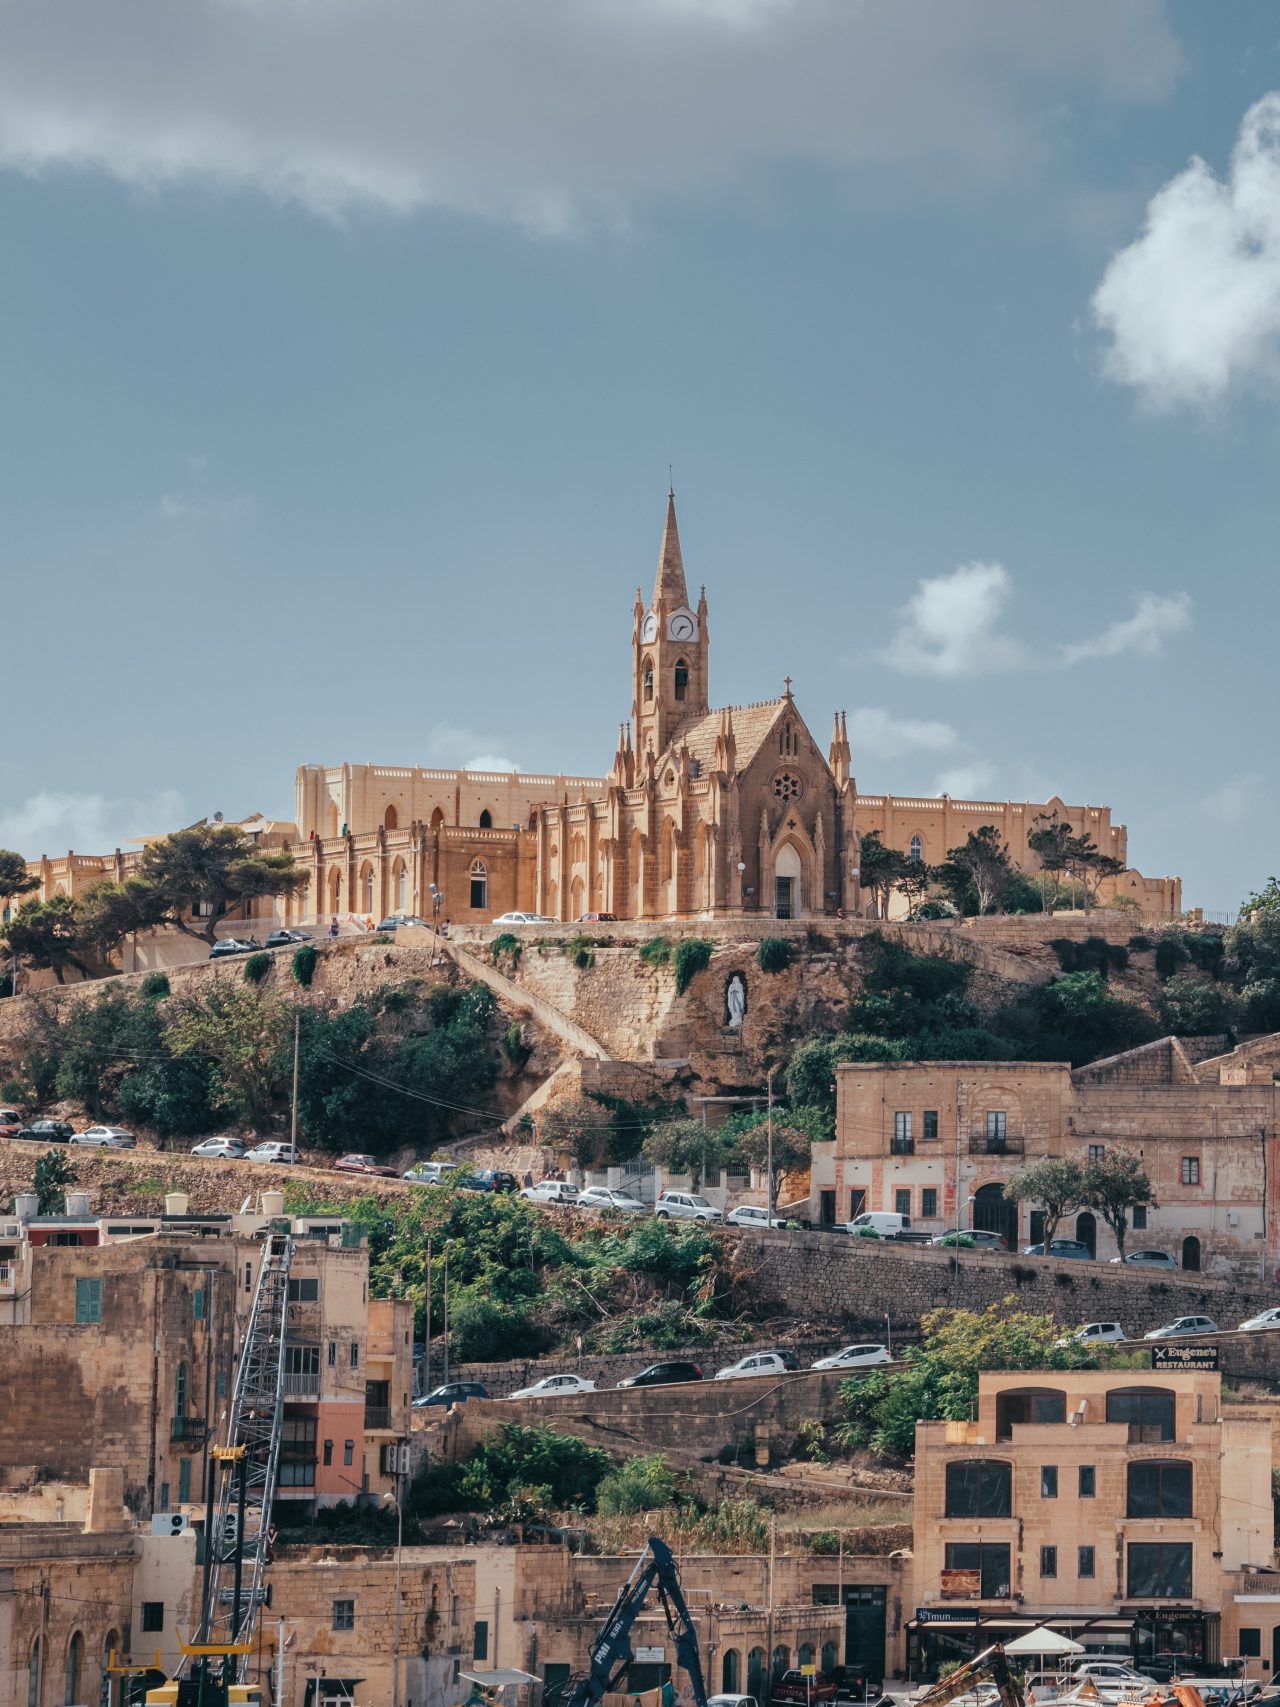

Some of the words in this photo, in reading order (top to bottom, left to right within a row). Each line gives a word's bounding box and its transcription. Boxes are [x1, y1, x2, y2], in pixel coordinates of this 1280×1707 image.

[1167, 1347, 1217, 1360] Eugene's
[926, 1612, 951, 1621] Tmun
[594, 1642, 611, 1665] PMI
[777, 1688, 804, 1697] TOYOTA
